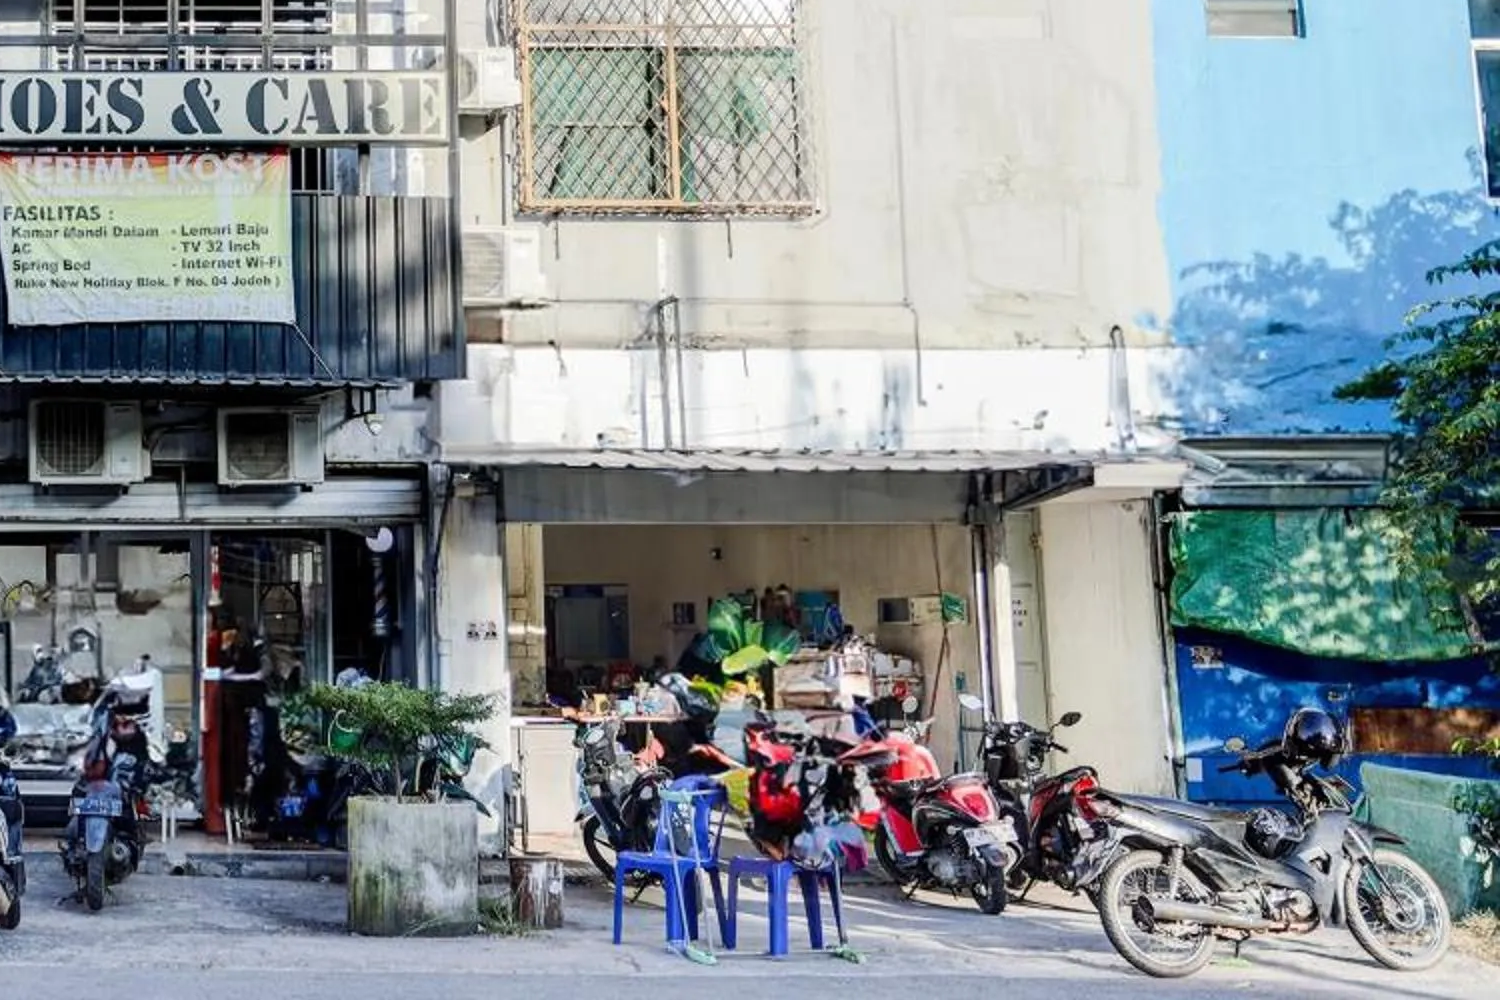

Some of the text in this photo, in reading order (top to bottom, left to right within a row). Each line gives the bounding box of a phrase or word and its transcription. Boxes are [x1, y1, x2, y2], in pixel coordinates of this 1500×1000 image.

[171, 77, 224, 136] &
[245, 76, 442, 137] CARE
[15, 151, 267, 184] TERIMA KOST
[2, 205, 101, 221] FASILITAS
[11, 226, 59, 238] Kamar
[112, 226, 159, 238] Dalam
[181, 223, 269, 237] Lemari Baju
[11, 243, 32, 255] AC
[181, 239, 261, 253] TV 32 Inch
[12, 258, 91, 274] Spring Bed
[181, 257, 241, 269] Internet
[50, 277, 79, 289] New
[83, 276, 132, 290] Holiday
[231, 275, 272, 287] Jodoh
